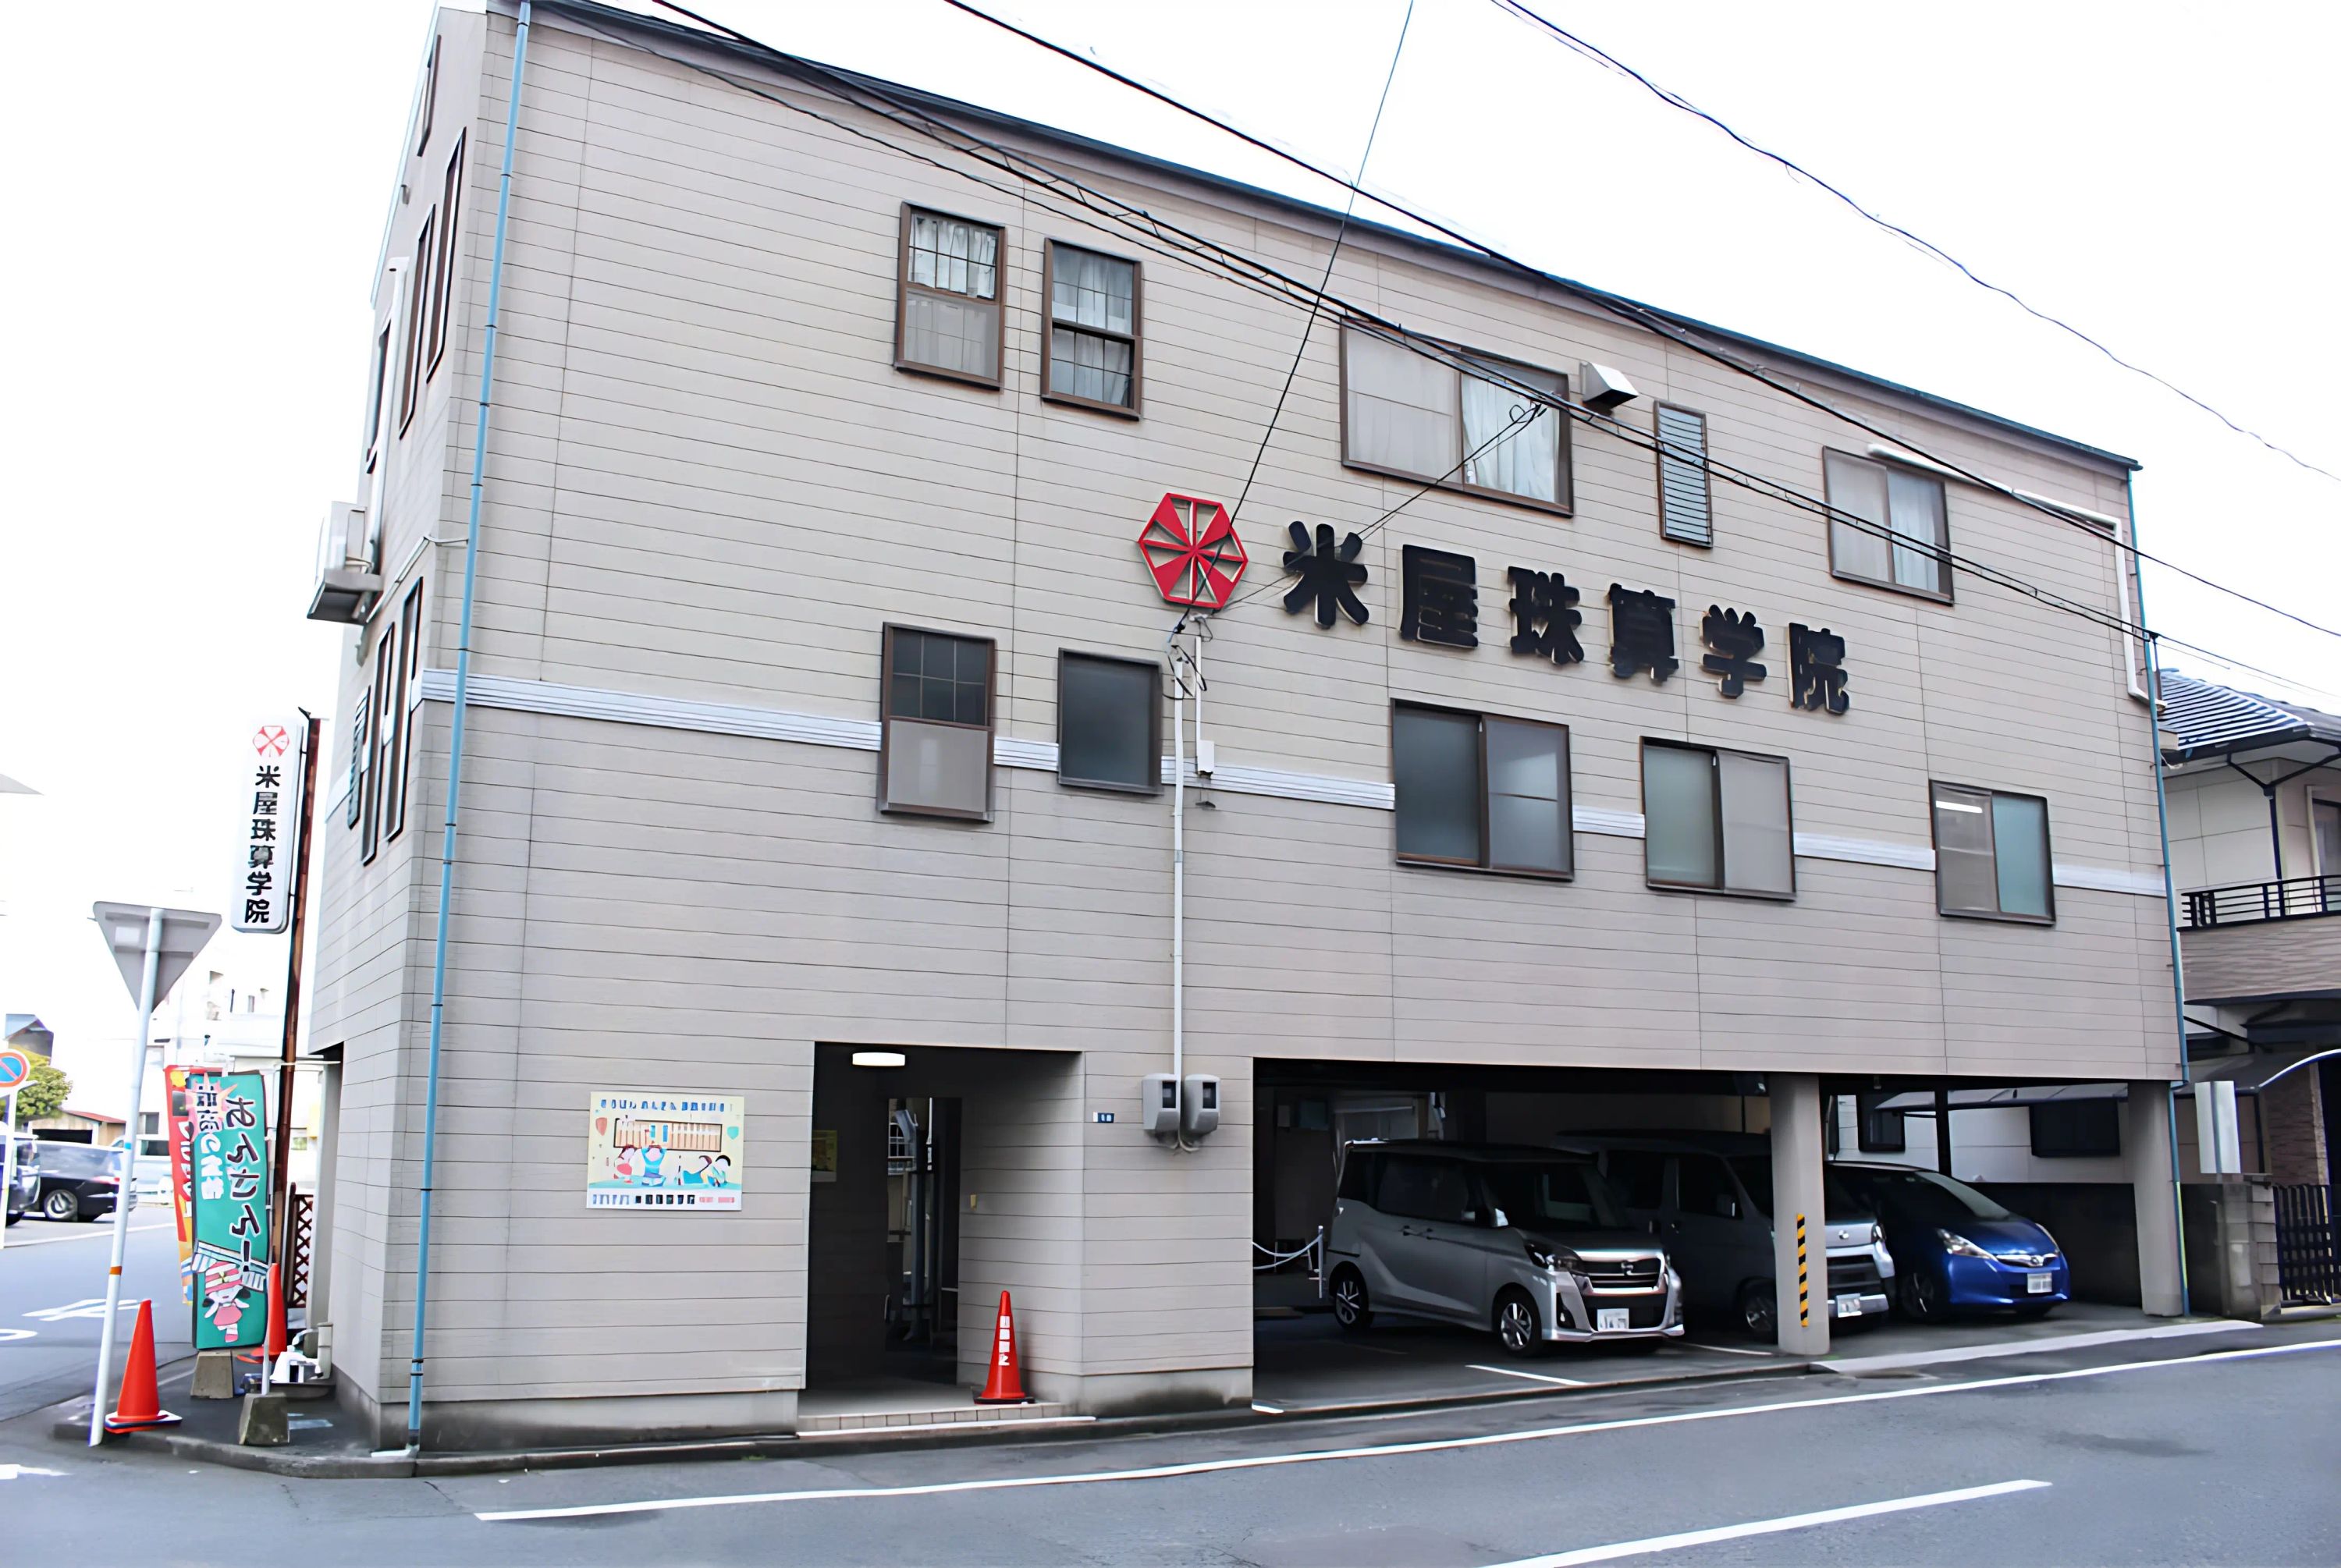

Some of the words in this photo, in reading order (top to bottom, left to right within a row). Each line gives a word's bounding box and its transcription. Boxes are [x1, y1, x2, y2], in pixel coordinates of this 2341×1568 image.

[1282, 520, 1850, 714] 米屋珠算学院
[244, 764, 282, 924] 米屋珠算学院
